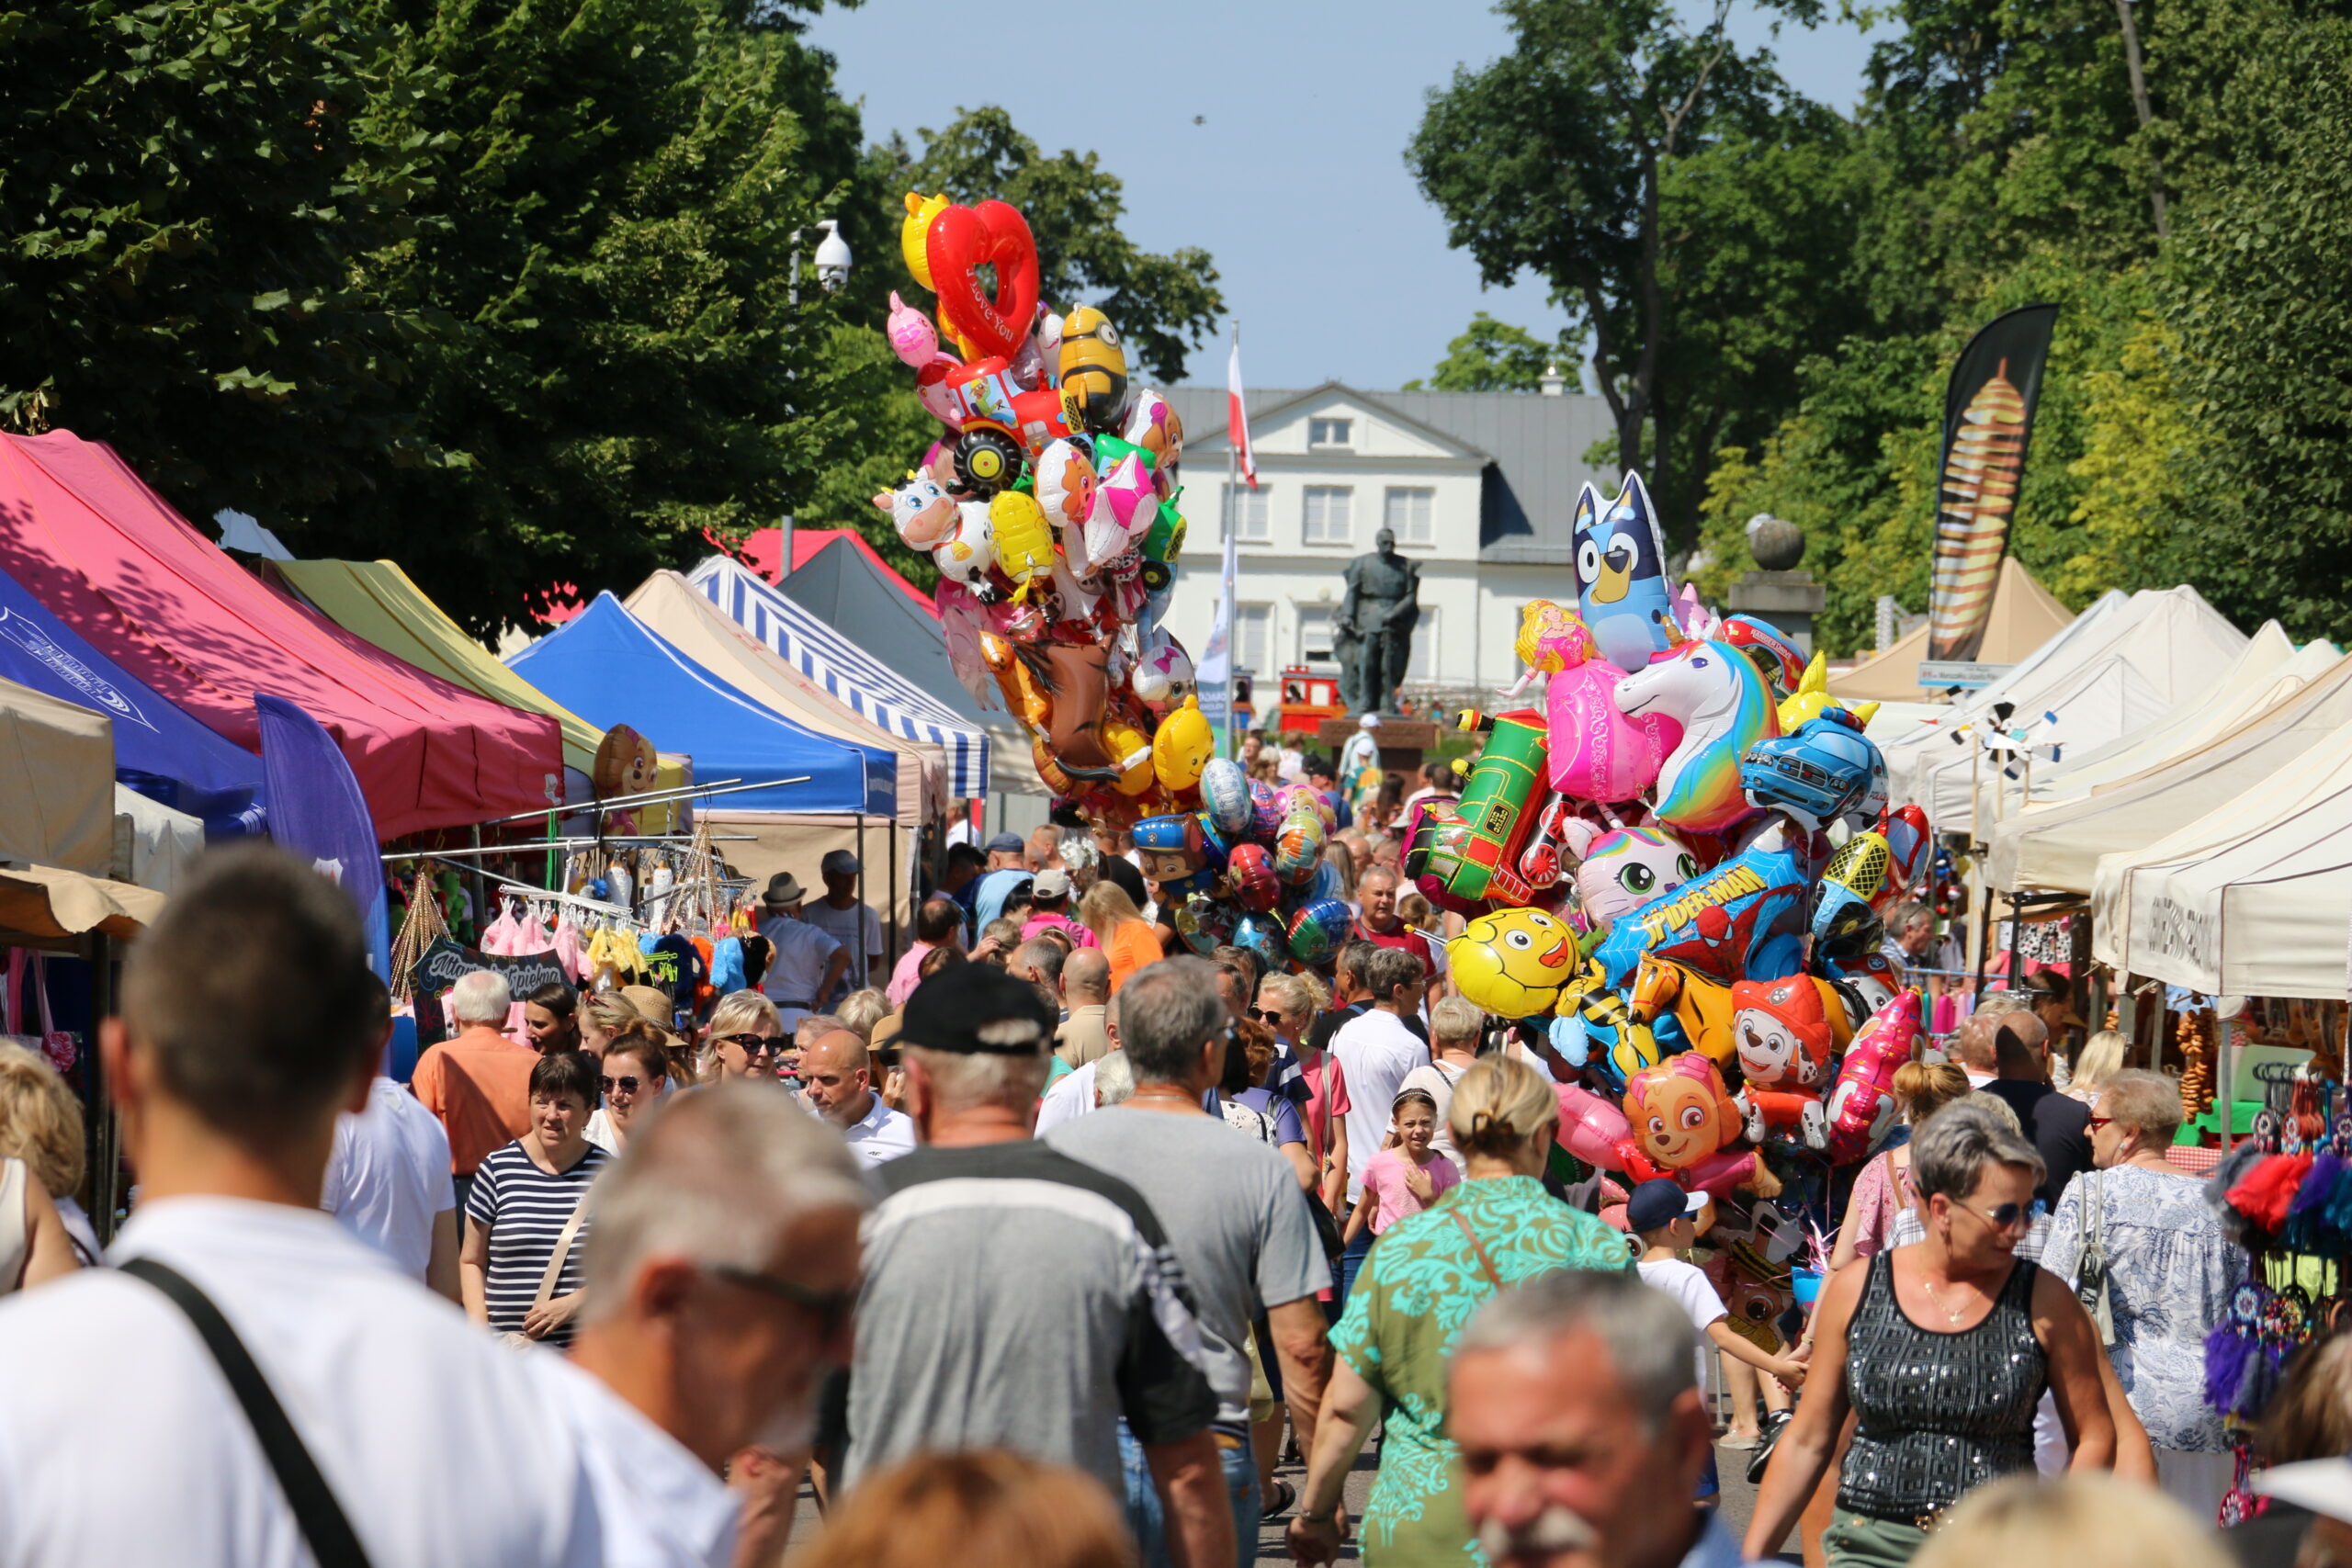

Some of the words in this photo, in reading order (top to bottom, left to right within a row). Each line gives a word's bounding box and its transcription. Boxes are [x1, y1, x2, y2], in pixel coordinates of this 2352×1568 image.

[969, 281, 993, 321] Love
[1750, 628, 1778, 649] RANGER
[1488, 811, 1500, 825] RIO
[1641, 864, 1769, 950] SPIDER-MAN
